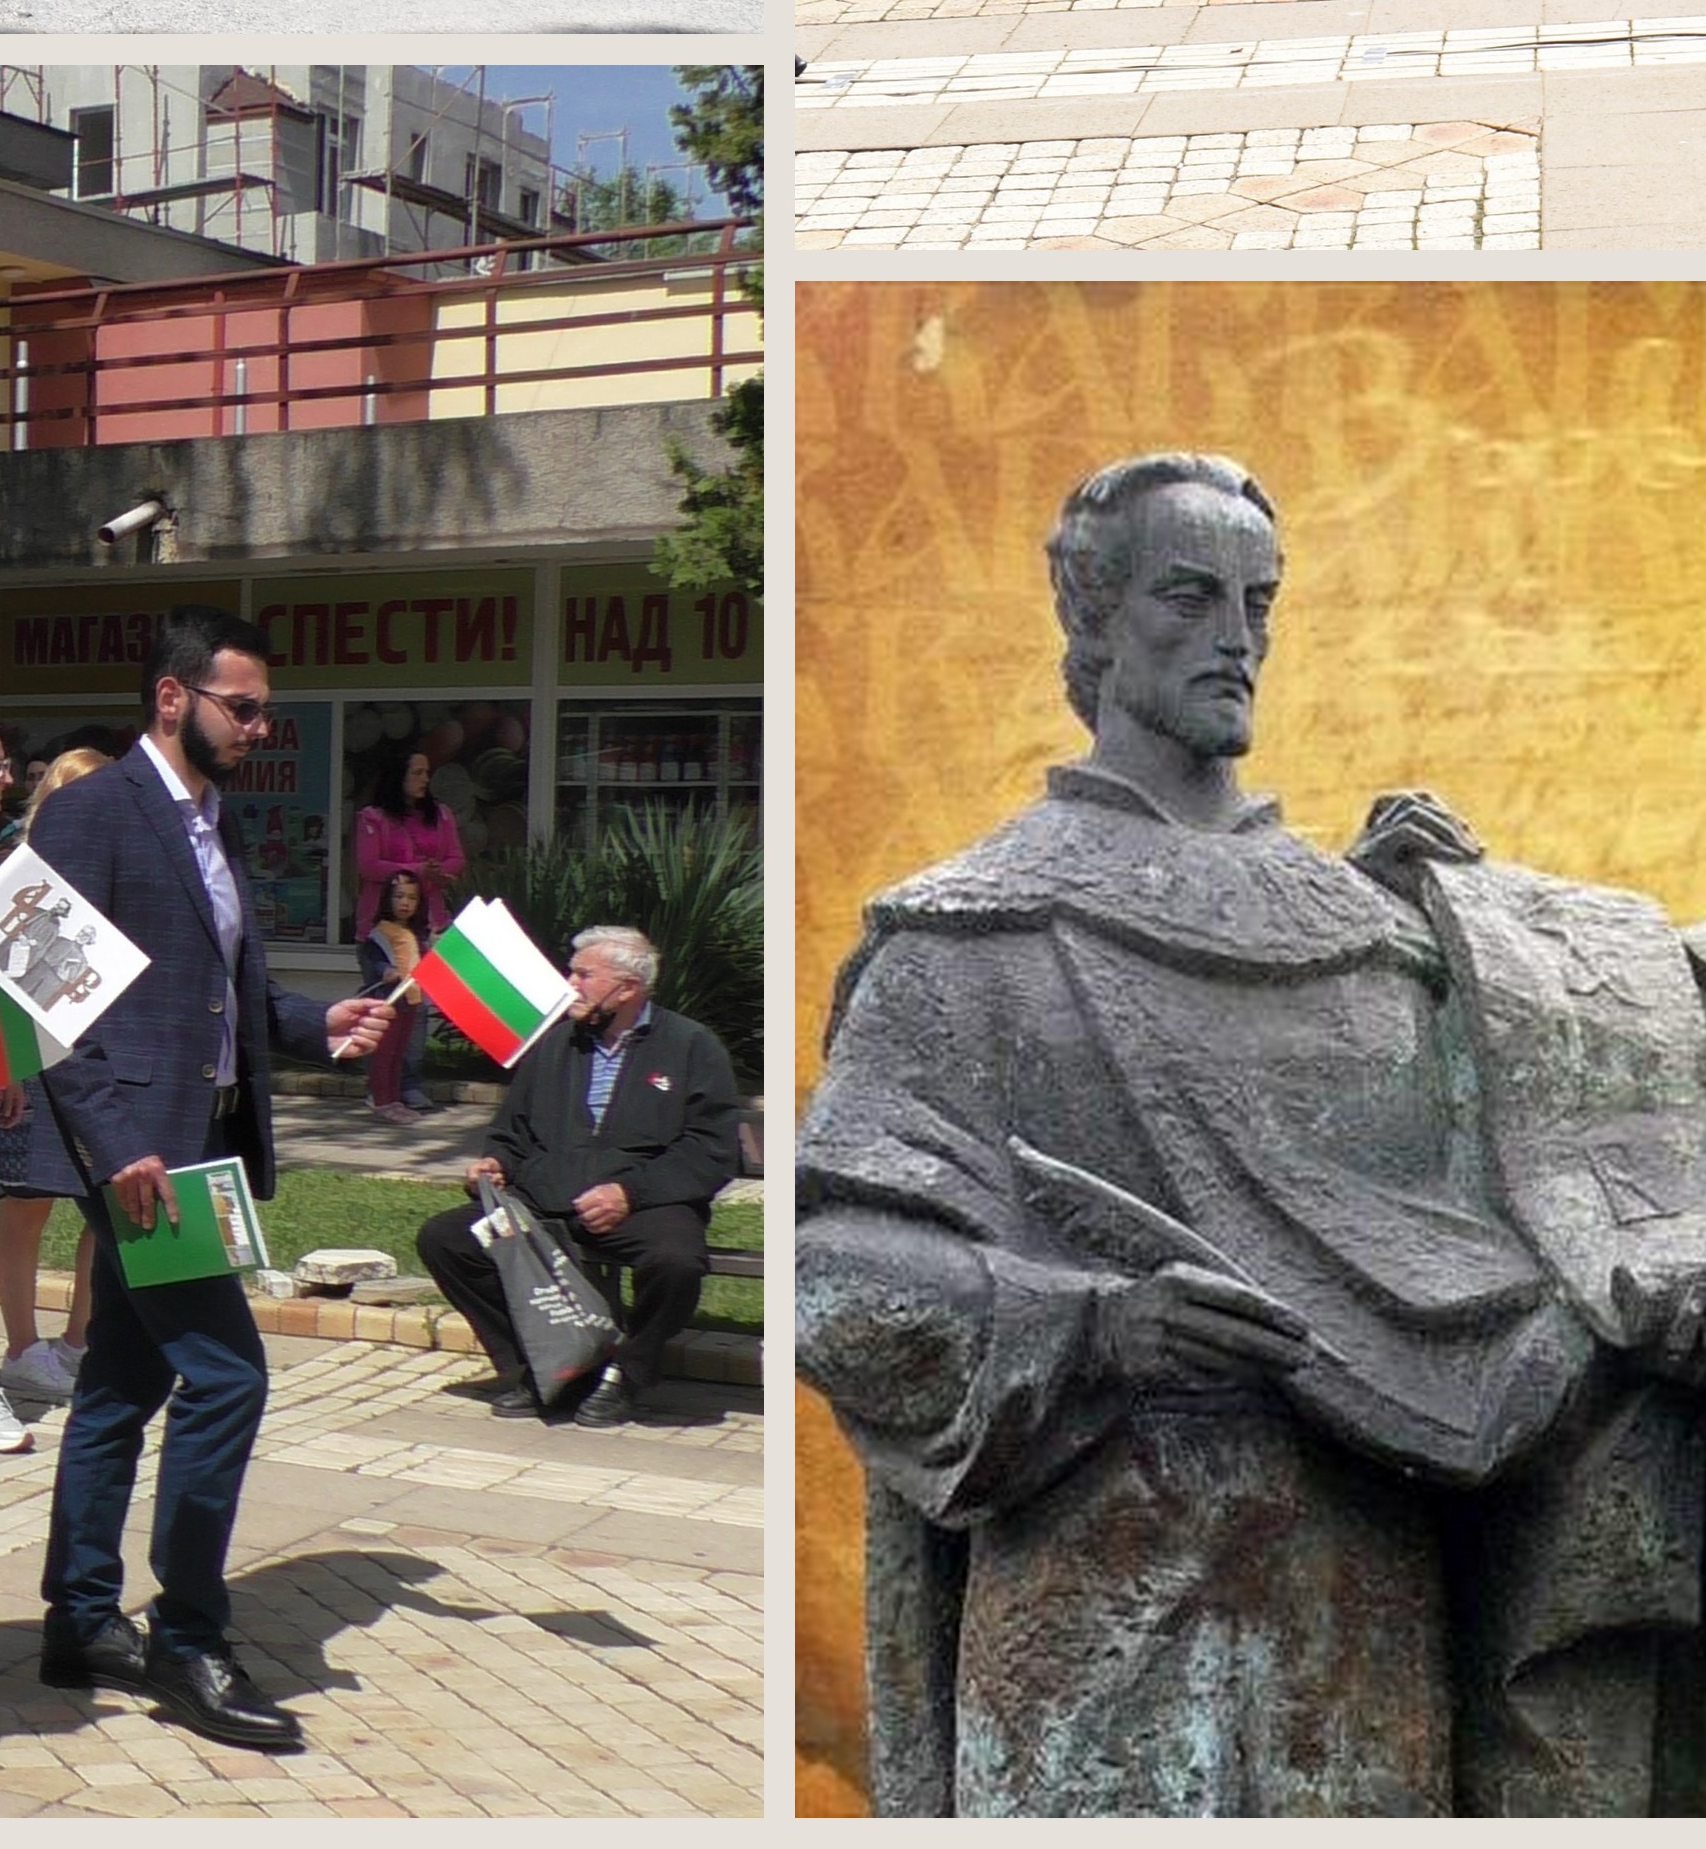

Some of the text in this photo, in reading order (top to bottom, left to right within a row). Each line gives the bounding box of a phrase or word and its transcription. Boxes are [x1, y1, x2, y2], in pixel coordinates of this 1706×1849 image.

[14, 609, 165, 667] МАГАЗ
[257, 596, 517, 667] СПЕСТИ!
[565, 597, 672, 672] НАД
